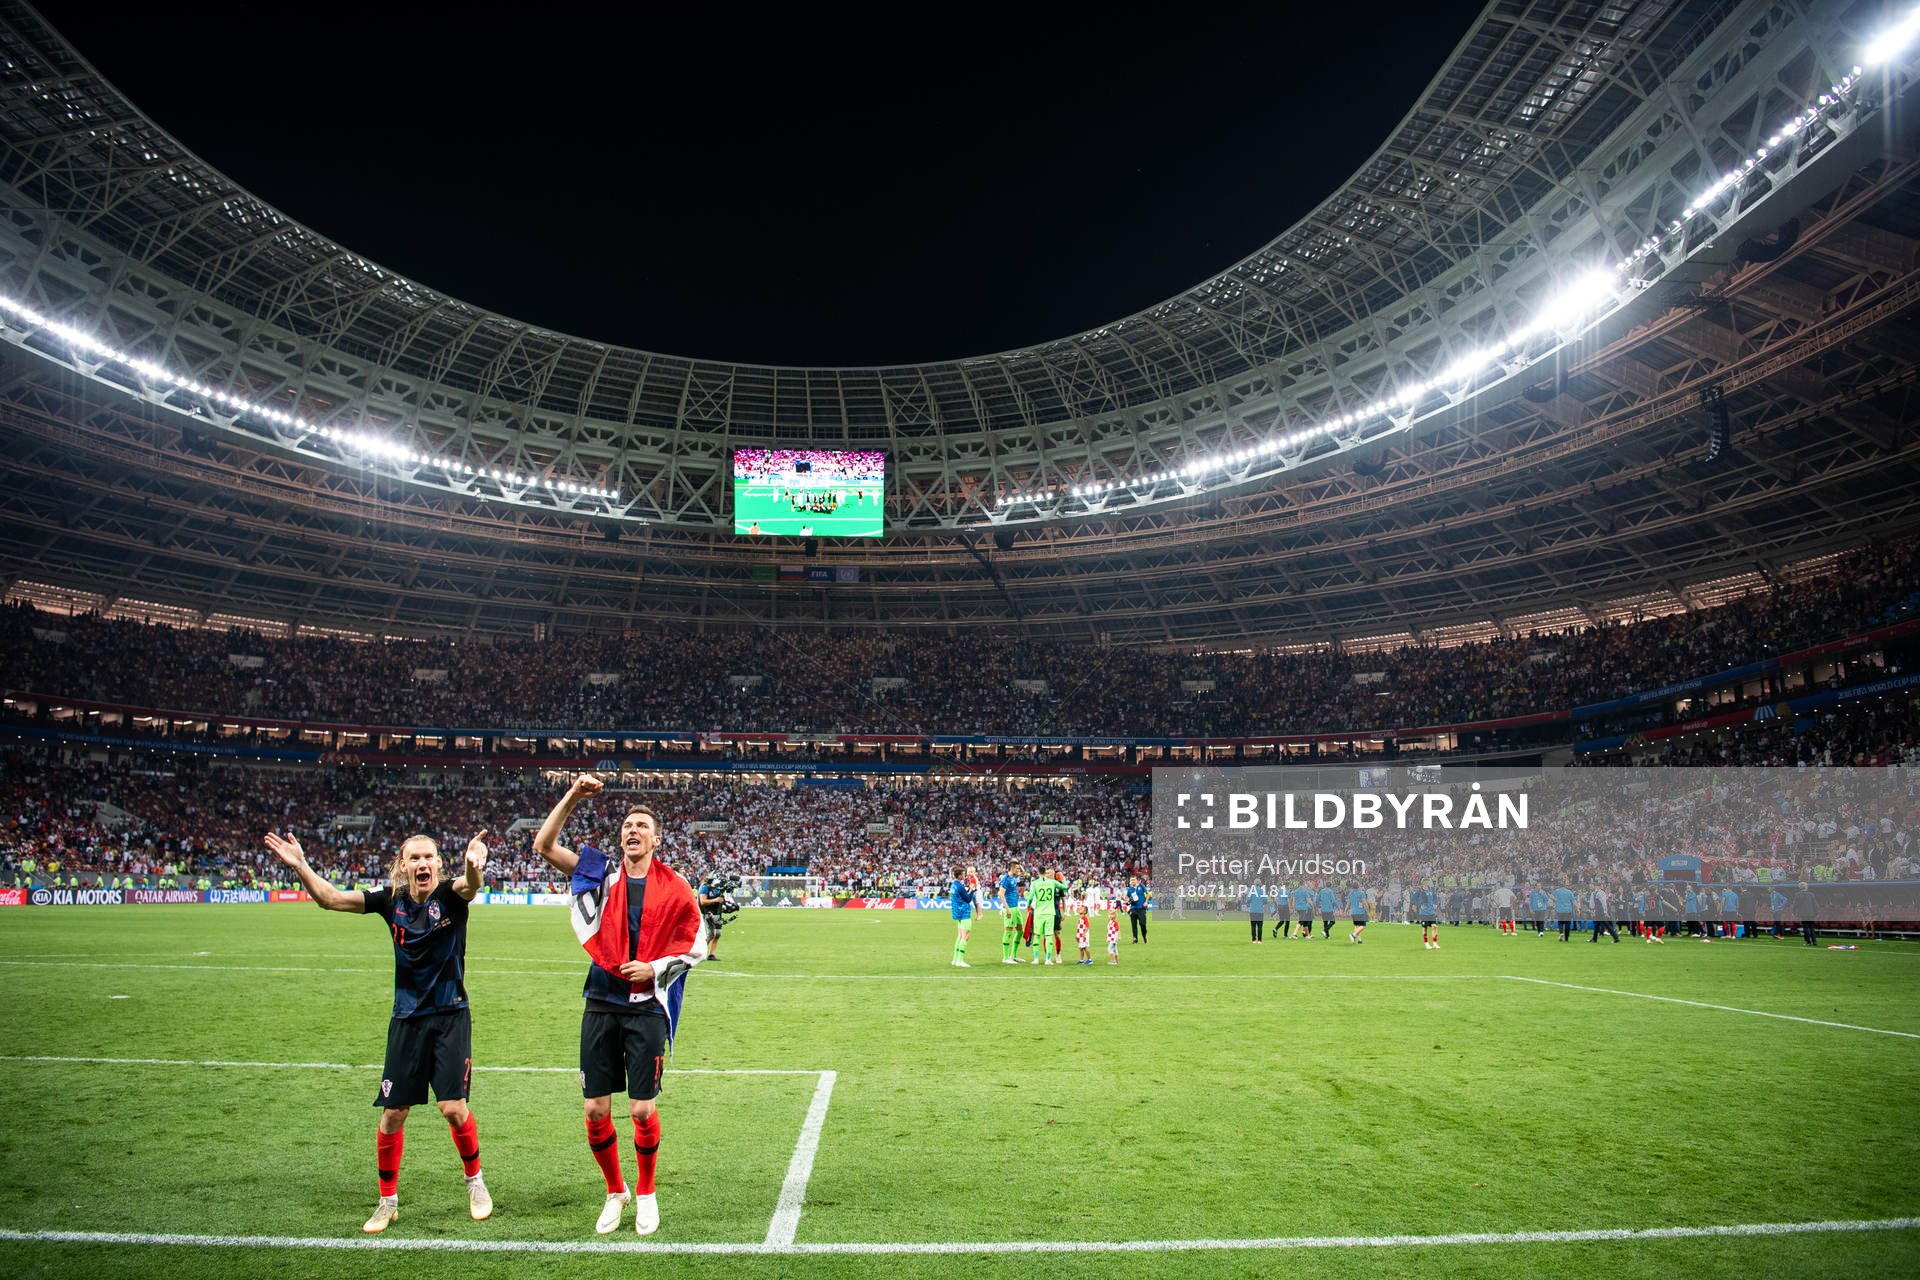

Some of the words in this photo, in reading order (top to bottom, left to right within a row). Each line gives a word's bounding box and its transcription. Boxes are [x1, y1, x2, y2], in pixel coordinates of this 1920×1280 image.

[1853, 687, 1867, 696] FIFA
[1868, 682, 1892, 693] WORLD
[1893, 678, 1908, 688] CUP
[53, 889, 75, 904] KIA
[76, 889, 121, 904] MOTORS
[135, 889, 163, 904] QATAR
[165, 890, 198, 902] AIRWAYS
[239, 890, 265, 903] WANDA
[1038, 888, 1053, 902] 23
[863, 898, 896, 909] Bud
